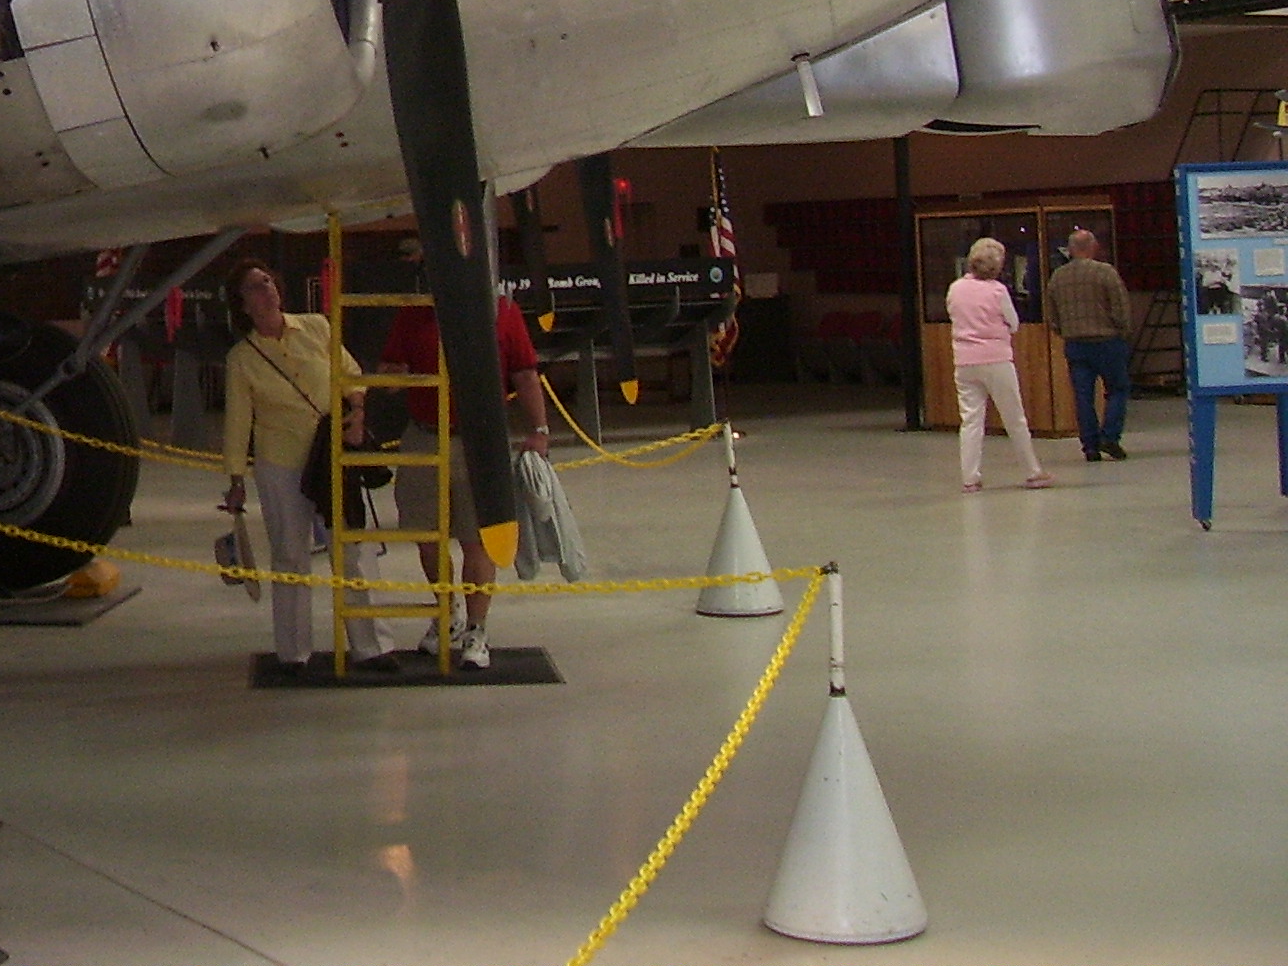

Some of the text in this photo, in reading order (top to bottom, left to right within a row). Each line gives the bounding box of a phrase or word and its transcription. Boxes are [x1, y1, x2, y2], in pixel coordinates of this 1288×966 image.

[628, 271, 655, 286] Killed
[656, 271, 666, 285] in
[667, 270, 700, 284] Service
